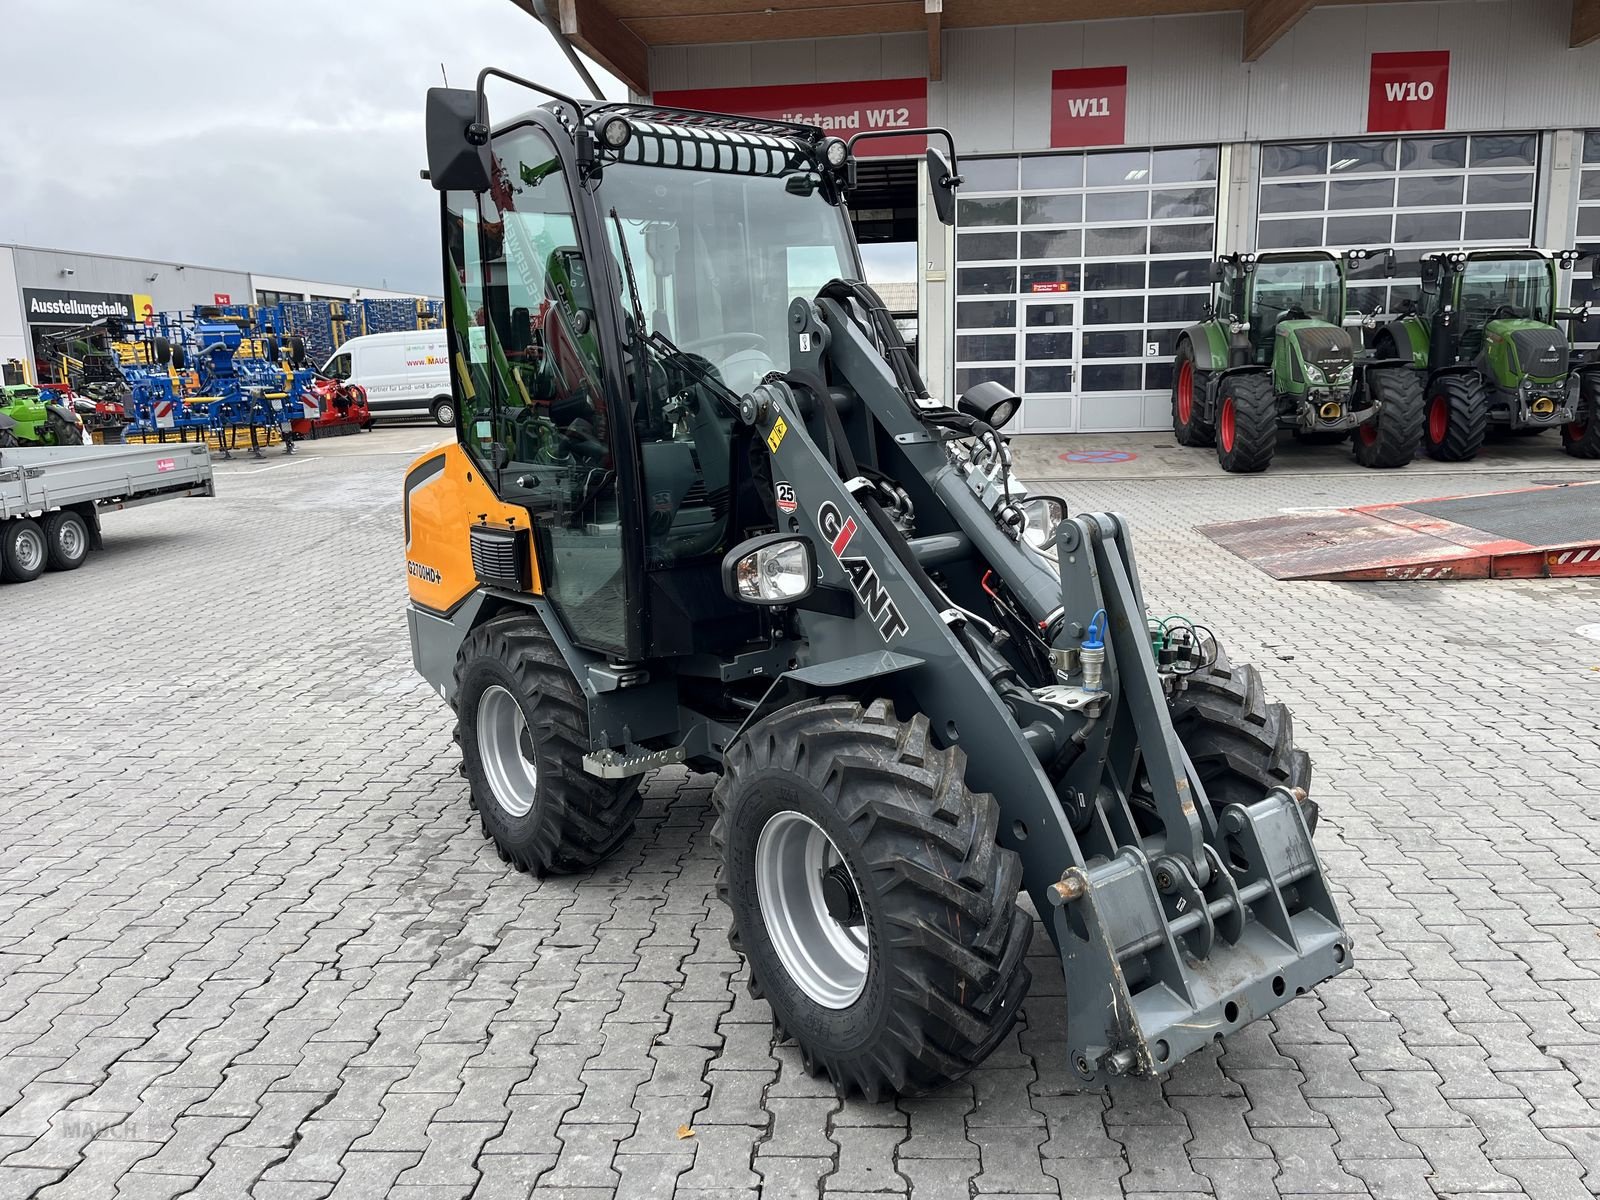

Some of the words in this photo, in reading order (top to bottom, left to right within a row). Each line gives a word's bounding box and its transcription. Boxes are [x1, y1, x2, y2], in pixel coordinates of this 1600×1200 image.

[1385, 81, 1434, 102] W10
[1068, 97, 1110, 118] W11
[779, 111, 859, 130] üfstand
[866, 108, 910, 128] W12
[31, 297, 128, 318] Ausstellungshalle
[1149, 343, 1156, 355] 5
[780, 486, 794, 502] 25
[408, 560, 442, 585] G2700HD+
[817, 500, 909, 643] GIANT
